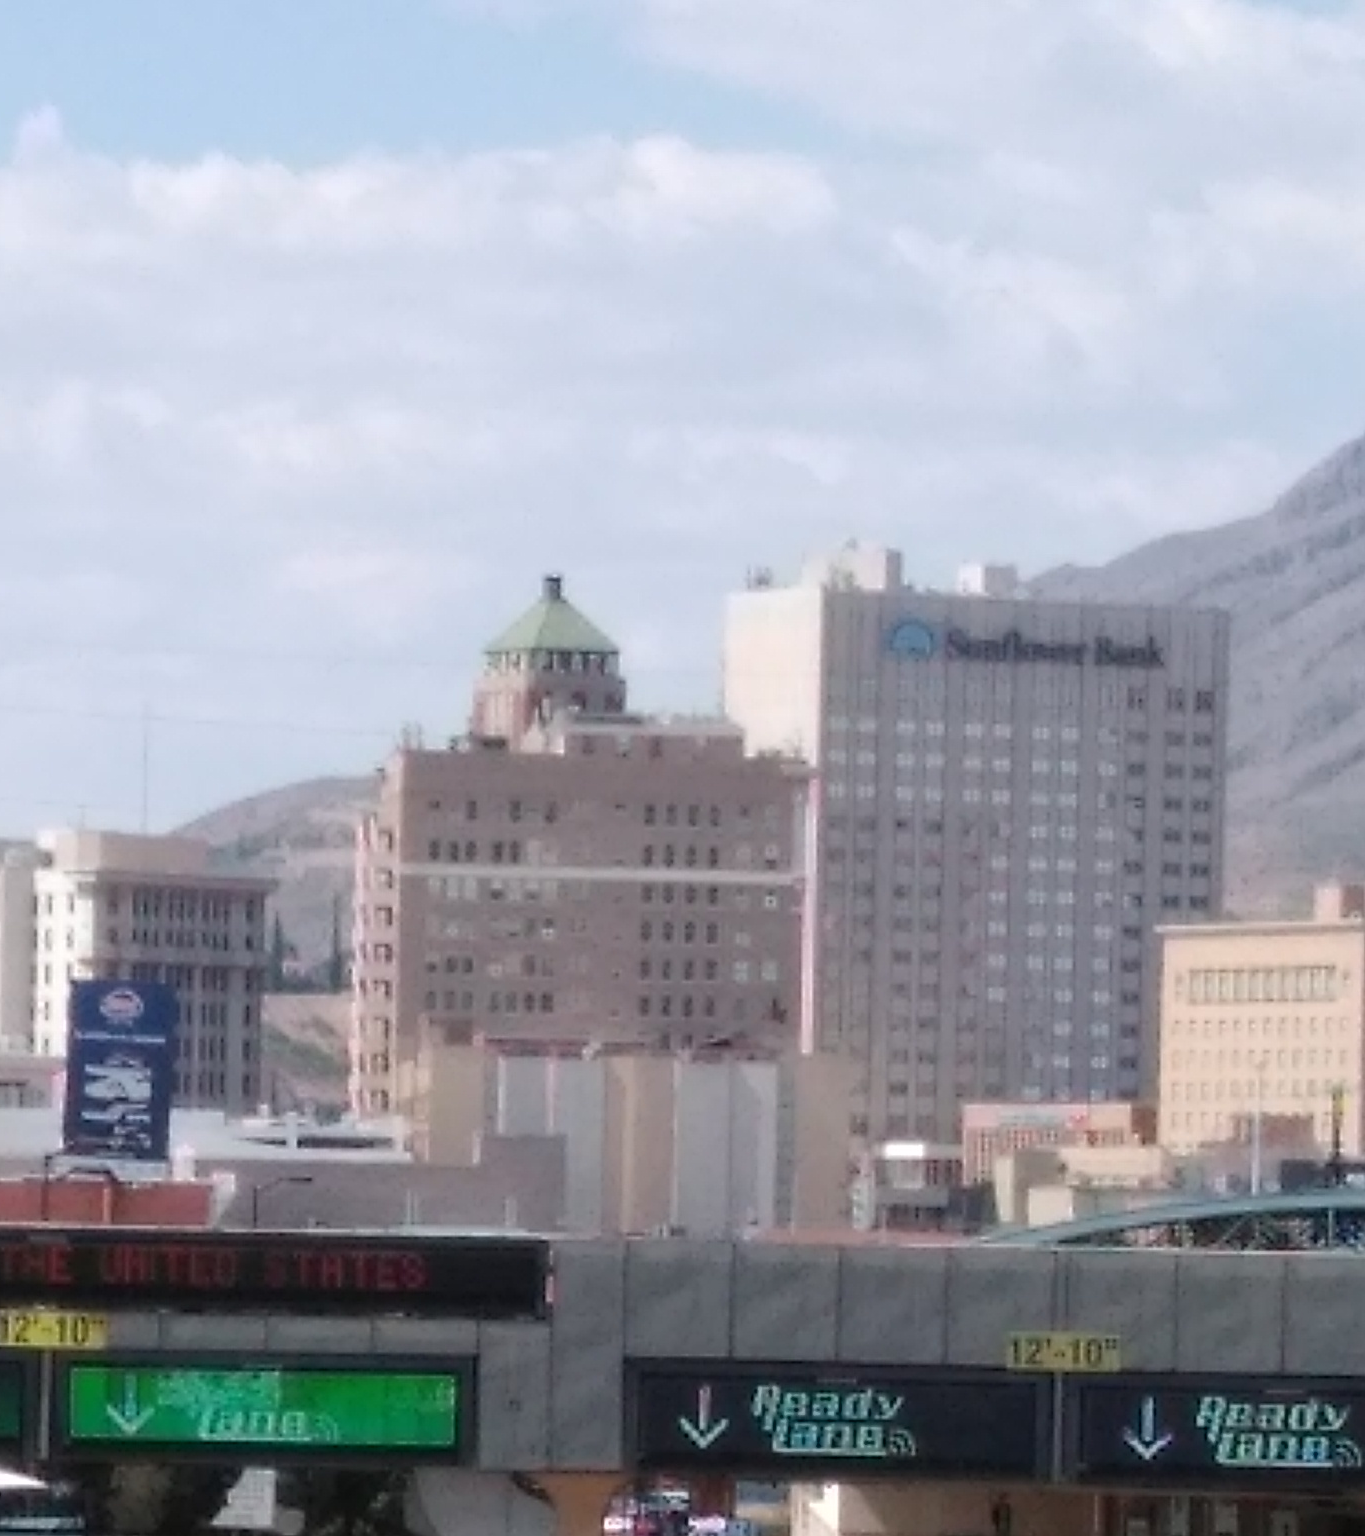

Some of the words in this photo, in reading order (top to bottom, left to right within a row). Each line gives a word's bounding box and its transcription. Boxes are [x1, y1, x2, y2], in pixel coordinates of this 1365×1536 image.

[1095, 634, 1164, 667] Bank
[0, 1244, 72, 1285] THE
[100, 1247, 236, 1287] UNITED
[267, 1251, 427, 1289] STATES
[751, 1384, 904, 1432] Ready
[1195, 1396, 1352, 1444] Ready
